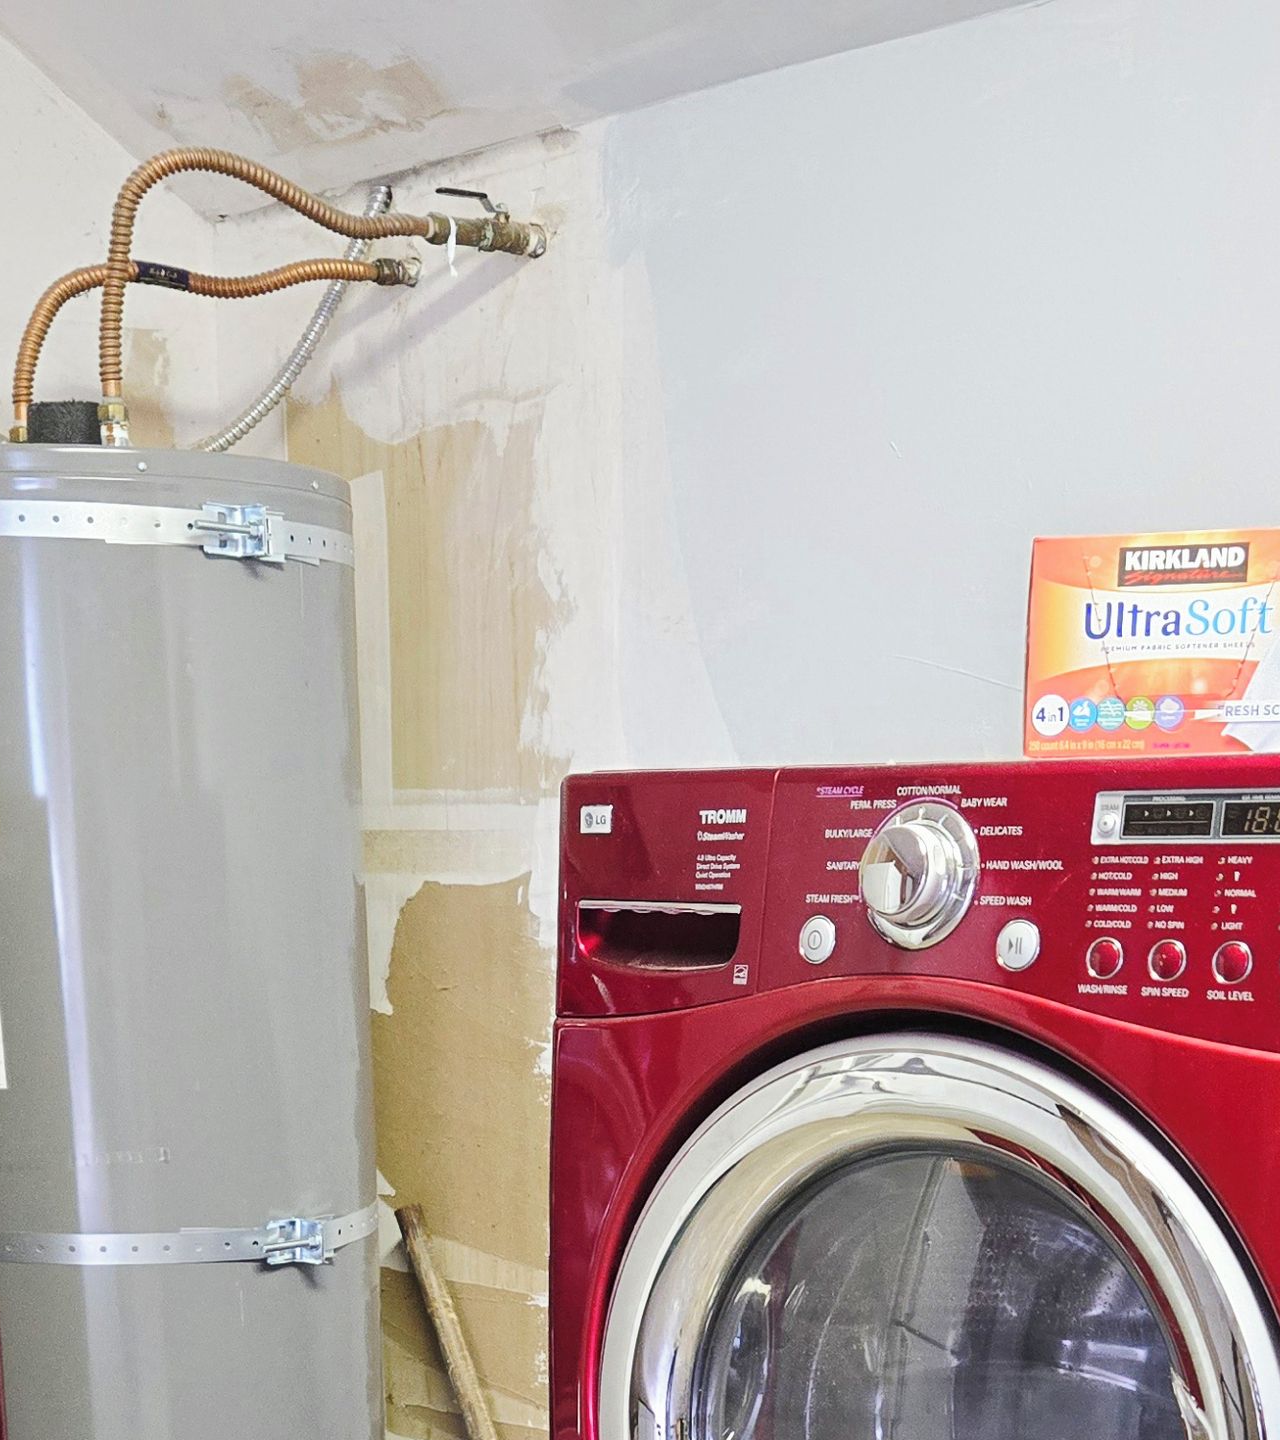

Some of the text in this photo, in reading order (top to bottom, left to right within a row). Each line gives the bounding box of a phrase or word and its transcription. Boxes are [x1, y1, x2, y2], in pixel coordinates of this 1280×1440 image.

[1125, 546, 1246, 571] KIRKLAND
[1124, 569, 1244, 585] Signature
[1084, 596, 1274, 640] UltraSoft
[896, 785, 962, 796] COTTON/NORMAL
[873, 799, 897, 809] PRESS
[960, 797, 1008, 808] BABY WEAR
[595, 814, 607, 826] LG
[698, 809, 748, 824] TROMM
[825, 828, 874, 839] BULKY/LARGE
[979, 826, 1023, 836] DELICATES
[986, 860, 1064, 870] HAND WASH/WOOL
[1162, 856, 1204, 864] EXTRA HIGH
[1227, 856, 1253, 864] HEAVY
[826, 861, 861, 871] SANITARY
[1159, 872, 1179, 880] HIGH
[1158, 888, 1188, 897] MEDIUM
[1224, 889, 1257, 898] NORMAL
[805, 894, 830, 903] STEAM
[979, 896, 1032, 906] SPEED WASH
[1156, 904, 1174, 913] LOW
[1155, 921, 1185, 930] NO SPIN
[1221, 922, 1243, 931] LIGHT
[1077, 984, 1128, 995] WASH/RINSE
[1141, 986, 1189, 998] SPIN SPEED
[1206, 990, 1255, 1002] SOIL LEVEL
